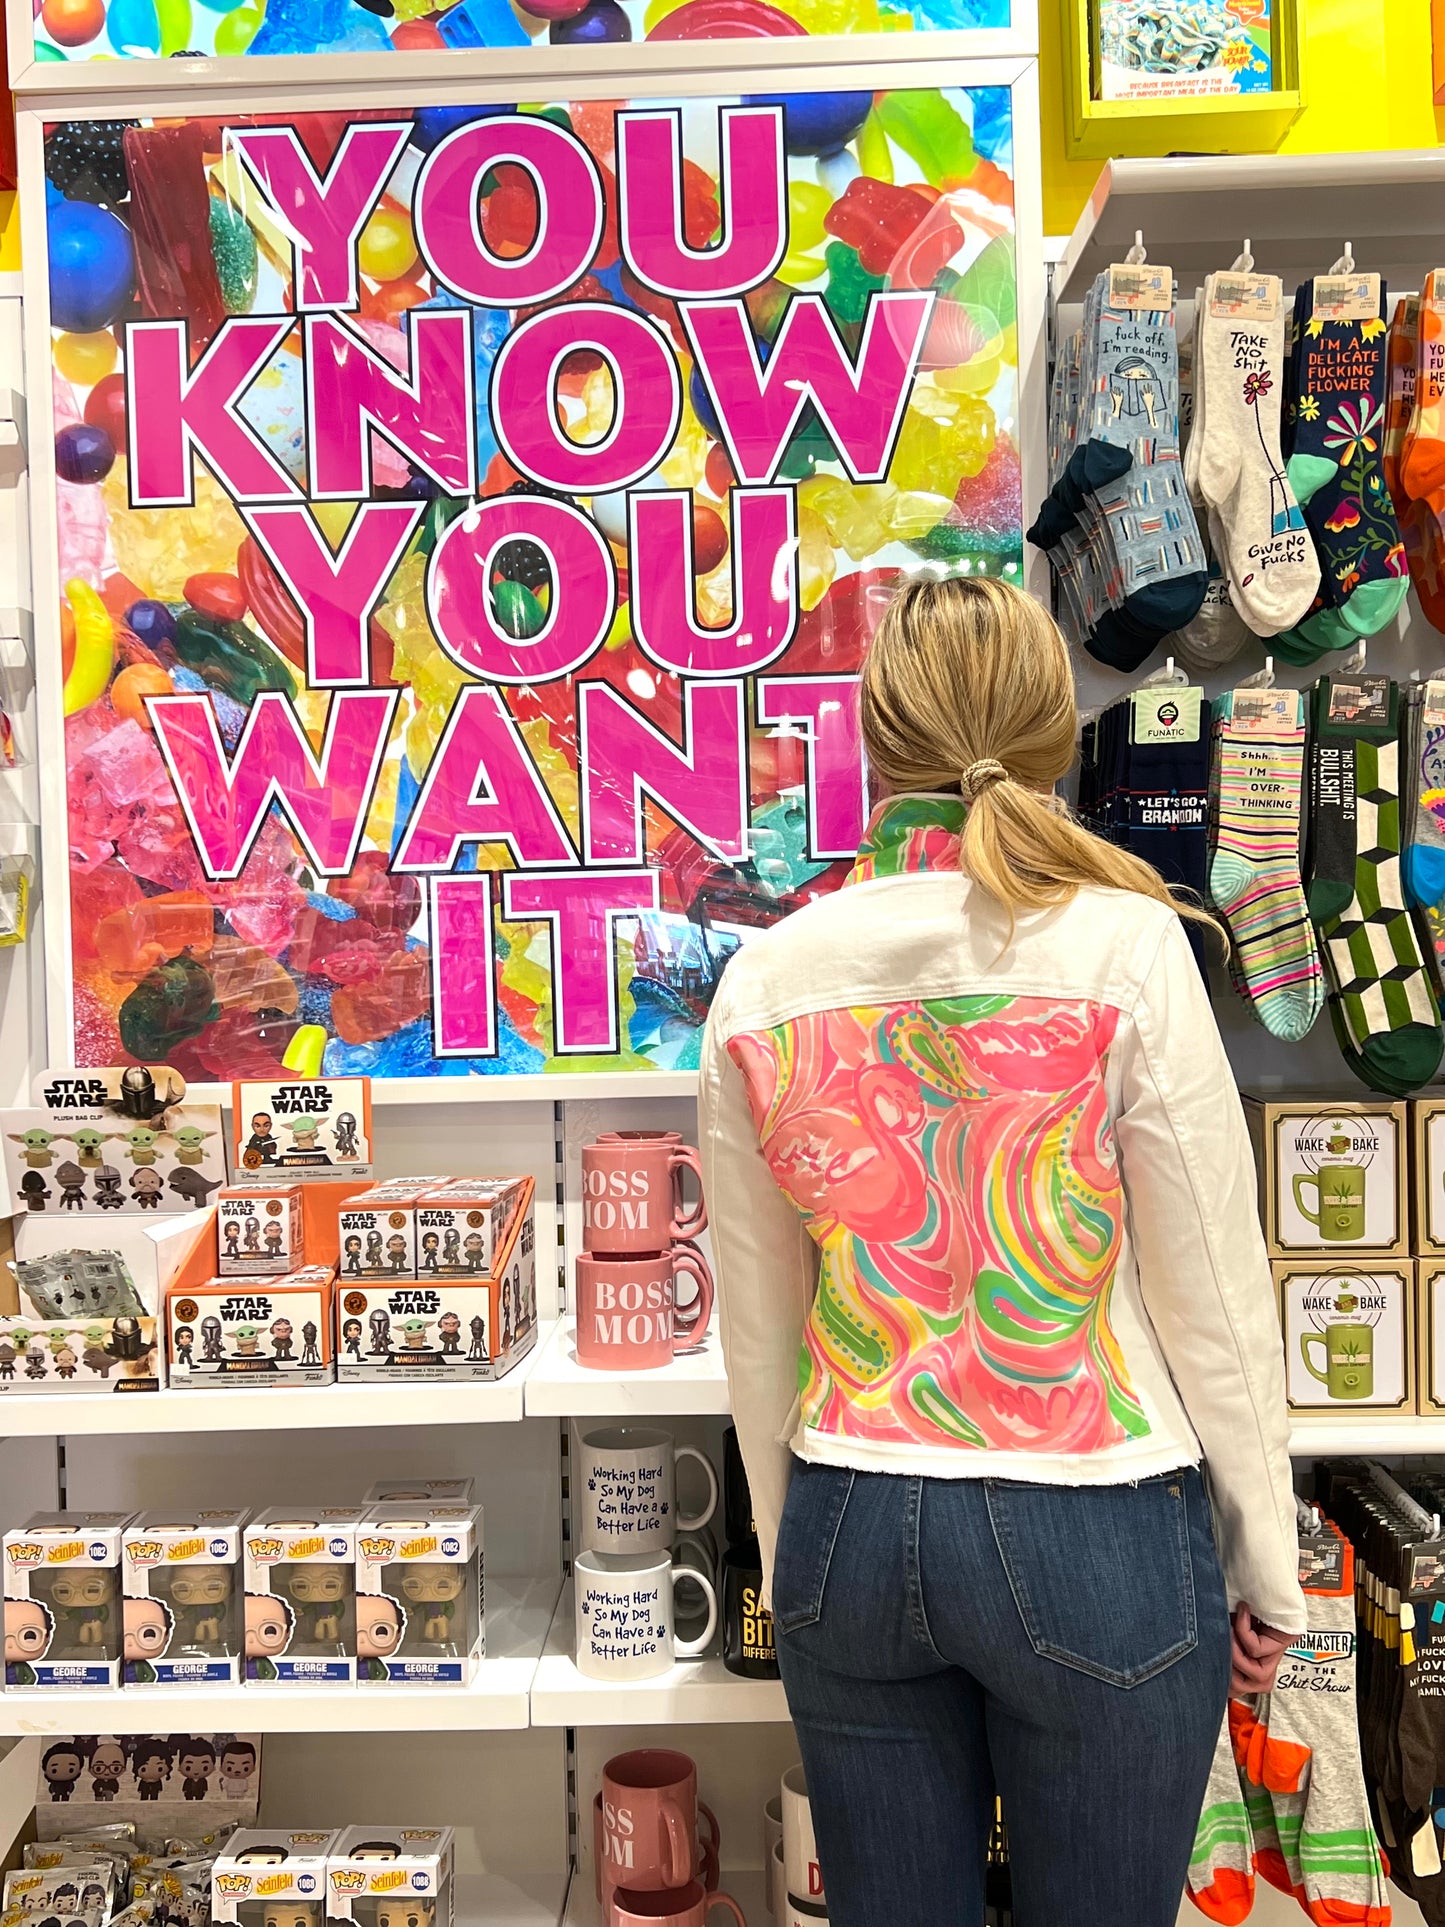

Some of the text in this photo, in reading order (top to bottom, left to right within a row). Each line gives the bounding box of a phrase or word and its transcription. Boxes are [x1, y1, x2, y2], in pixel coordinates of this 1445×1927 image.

[1211, 78, 1223, 86] THE
[222, 104, 790, 313] YOU
[1115, 326, 1165, 346] fuck off.
[1230, 331, 1269, 348] TAKE
[1102, 339, 1172, 364] I'm reading.
[1319, 337, 1360, 351] I'M A
[1236, 346, 1262, 358] NO
[1308, 351, 1380, 365] DELICATE
[1308, 365, 1375, 379] FUCKING
[1307, 378, 1371, 394] FLOWER
[125, 290, 937, 508] KNOW
[238, 487, 799, 691] YOU
[1147, 728, 1185, 737] FUNATIC
[1249, 768, 1266, 777] I'M
[1319, 748, 1341, 807] BULLSHIT.
[1250, 784, 1285, 793] OVER-
[1342, 749, 1355, 821] THIS MEETING IS
[1147, 796, 1198, 808] LET'S GO
[1239, 798, 1293, 809] THINKING
[1142, 809, 1202, 824] BRANDON
[428, 866, 660, 1059] IT
[44, 1080, 108, 1094] STAR
[271, 1085, 333, 1100] STAR
[44, 1093, 108, 1108] WARS
[271, 1099, 333, 1114] WARS
[1294, 1138, 1324, 1151] WAKE
[1352, 1138, 1379, 1151] BAKE
[220, 1200, 255, 1208] STAR
[221, 1208, 255, 1216] WARS
[341, 1213, 377, 1222] STAR
[419, 1210, 455, 1219] STAR
[584, 1200, 649, 1230] OM
[341, 1221, 377, 1230] WARS
[419, 1218, 456, 1227] WARS
[388, 1290, 440, 1303] STAR
[594, 1278, 673, 1311] BOSS
[219, 1297, 272, 1310] STAR
[388, 1303, 441, 1315] WARS
[1302, 1297, 1332, 1310] WAKE
[1360, 1296, 1387, 1309] BAKE
[220, 1309, 273, 1321] WARS
[593, 1310, 673, 1345] MOM
[393, 1355, 437, 1364] MANDALORIAN
[593, 1466, 662, 1484] Working Hard
[601, 1485, 655, 1501] So My Dog
[598, 1499, 658, 1515] Can Have a
[597, 1516, 660, 1535] Better Life
[48, 1541, 85, 1561] Seinfeld
[168, 1538, 206, 1558] Seinfeld
[288, 1536, 325, 1557] Seinfeld
[400, 1536, 437, 1557] Seinfeld
[586, 1588, 658, 1608] Working Hard
[595, 1608, 650, 1626] So My Dog
[592, 1623, 653, 1640] Can Have a
[591, 1640, 657, 1660] Better Life
[52, 1667, 87, 1676] GEORGE
[172, 1664, 208, 1674] GEORGE
[293, 1663, 328, 1673] GEORGE
[404, 1664, 440, 1673] GEORGE
[1314, 1667, 1336, 1675] THE
[1277, 1674, 1351, 1692] Shit Show
[13, 1875, 44, 1895] Seinfeld
[256, 1872, 294, 1893] Seinfeld
[370, 1870, 408, 1891] Seinfeld
